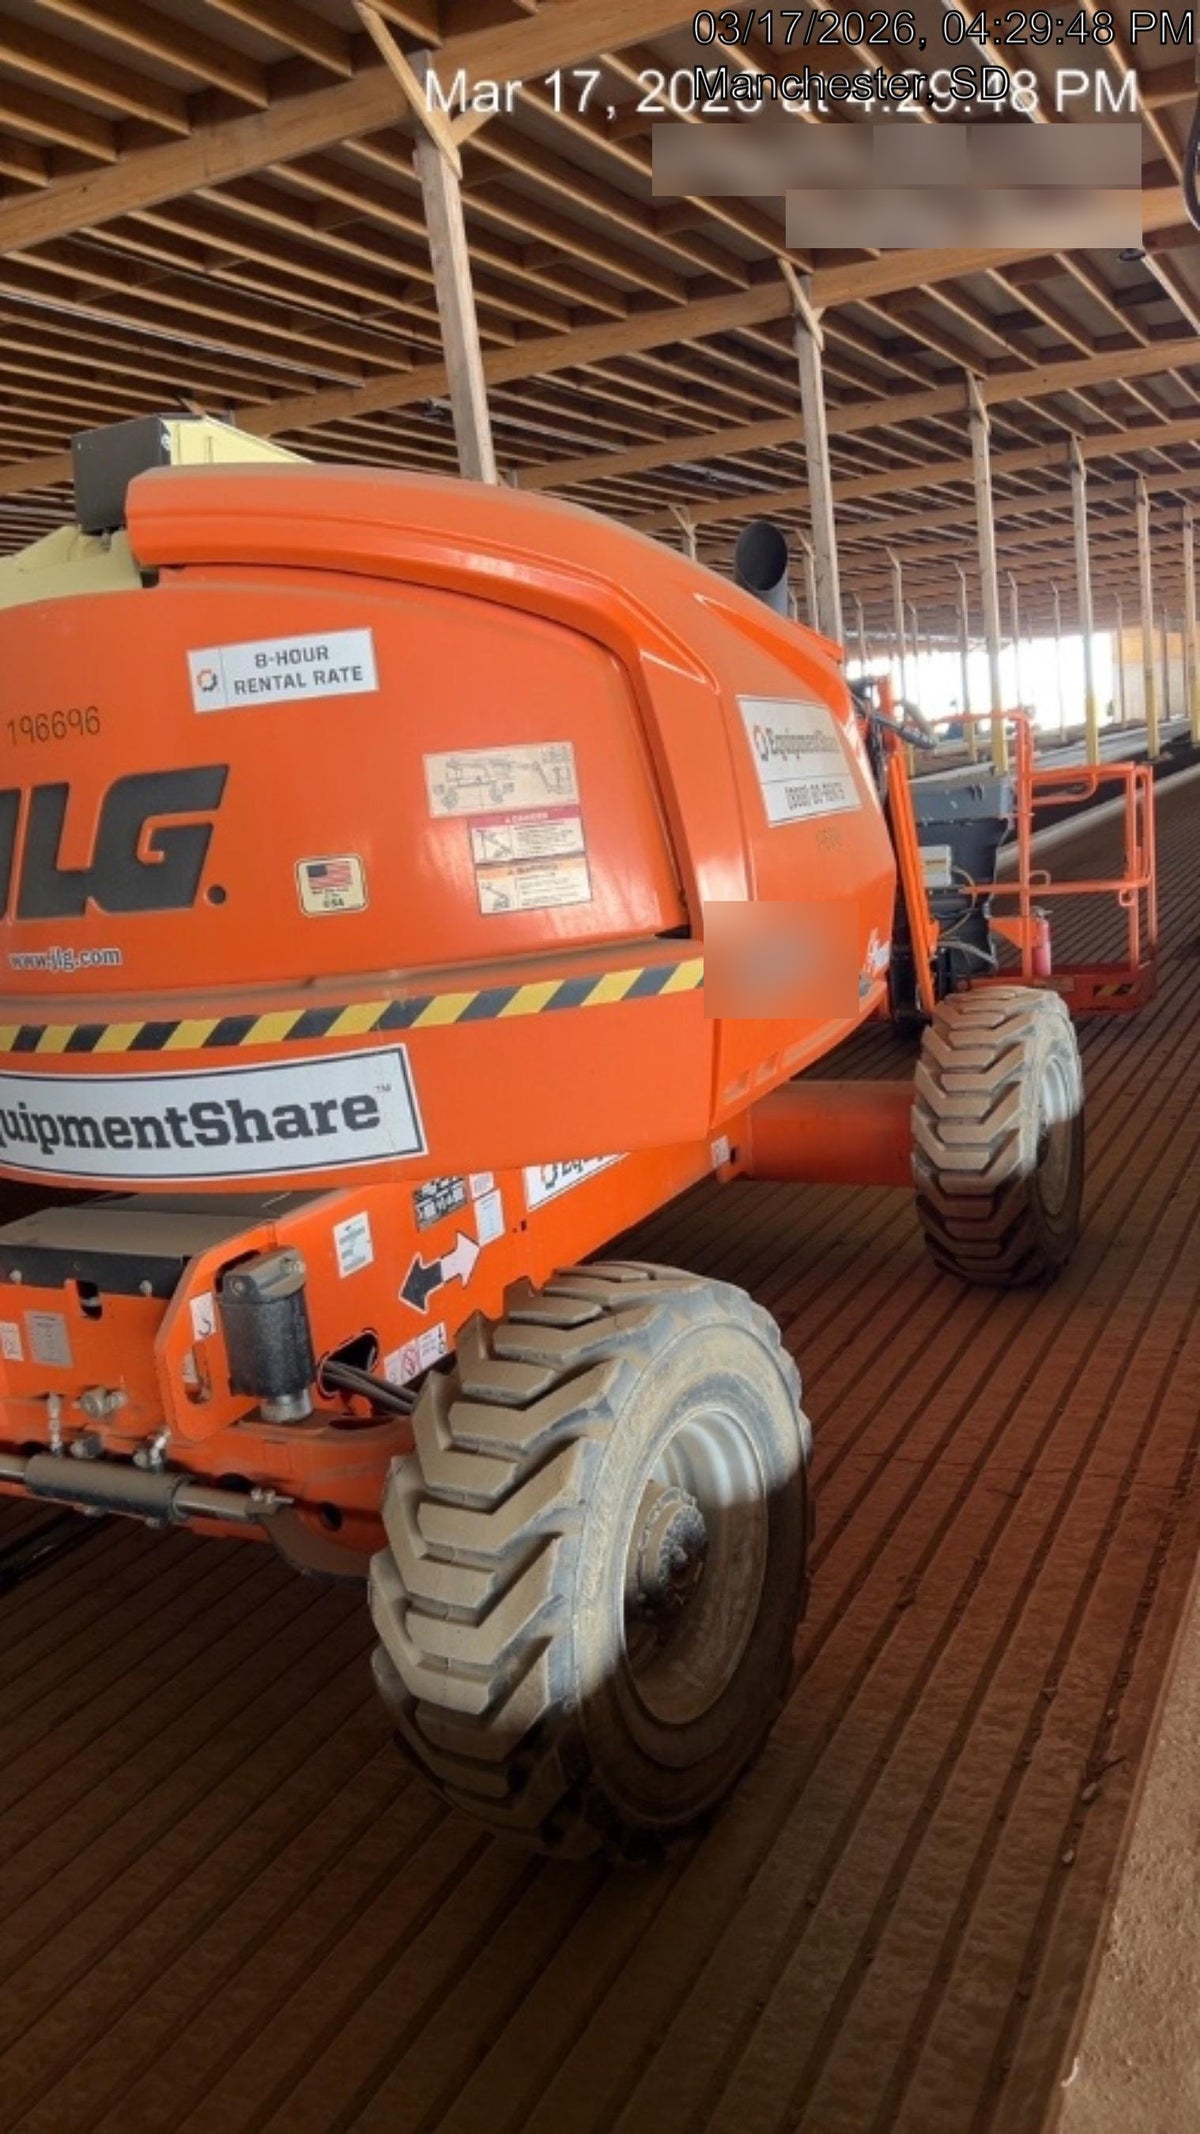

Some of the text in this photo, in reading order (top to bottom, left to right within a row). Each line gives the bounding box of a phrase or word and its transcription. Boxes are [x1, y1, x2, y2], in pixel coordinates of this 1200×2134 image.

[255, 645, 329, 669] 8-HOUR
[234, 665, 363, 696] RENTAL RATE
[7, 705, 101, 747] 196696
[9, 946, 121, 973] www.jlg.com
